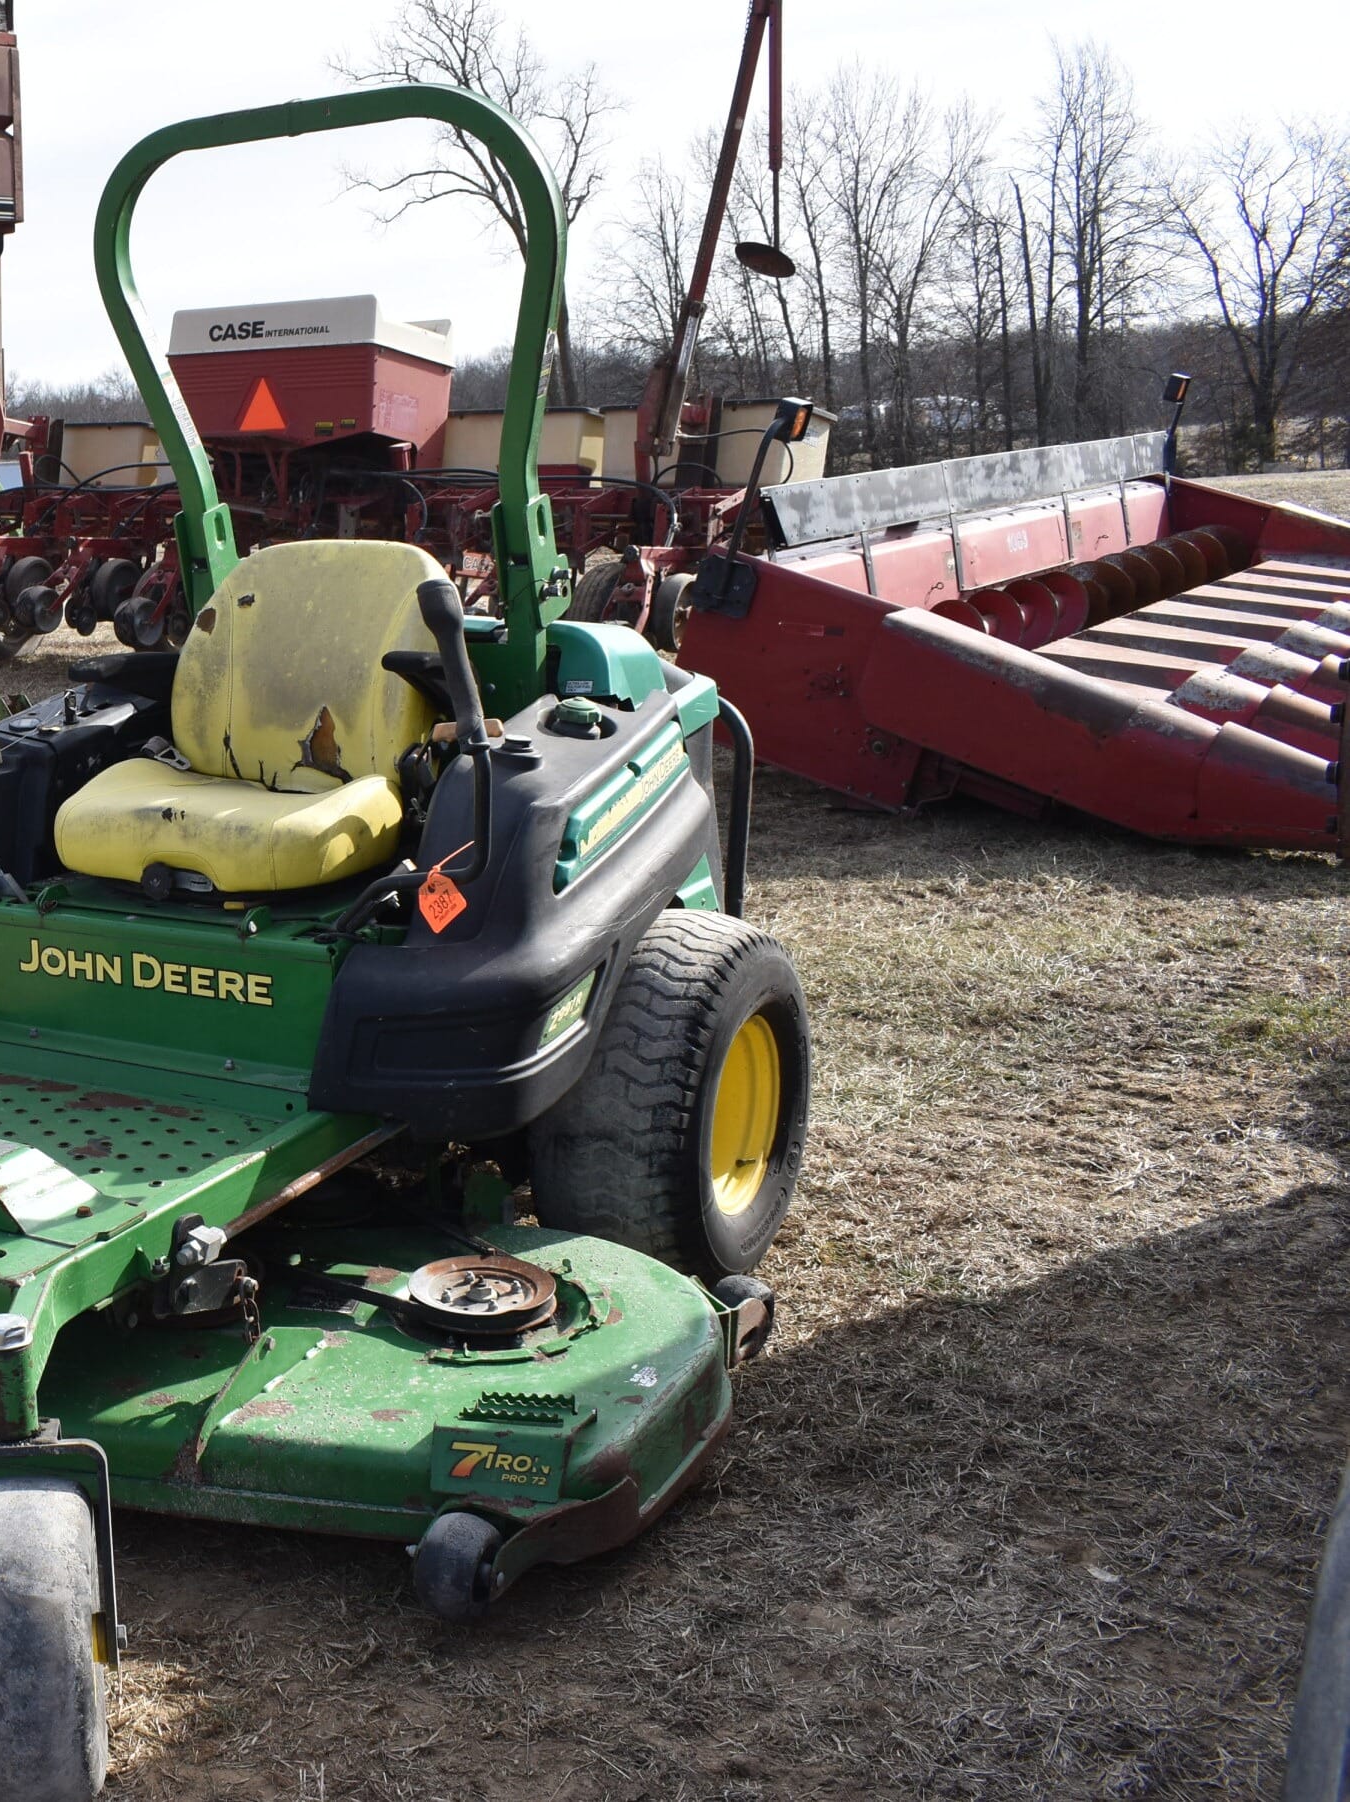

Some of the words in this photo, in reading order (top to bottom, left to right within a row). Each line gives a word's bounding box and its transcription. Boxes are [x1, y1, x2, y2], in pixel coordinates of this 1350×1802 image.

[209, 320, 265, 342] CASE
[265, 325, 330, 339] INTERNATIONAL
[428, 890, 453, 919] 2387
[20, 938, 122, 985] JOHN
[131, 952, 274, 1007] DEERE
[501, 1473, 527, 1484] PRO
[531, 1476, 547, 1486] 72
